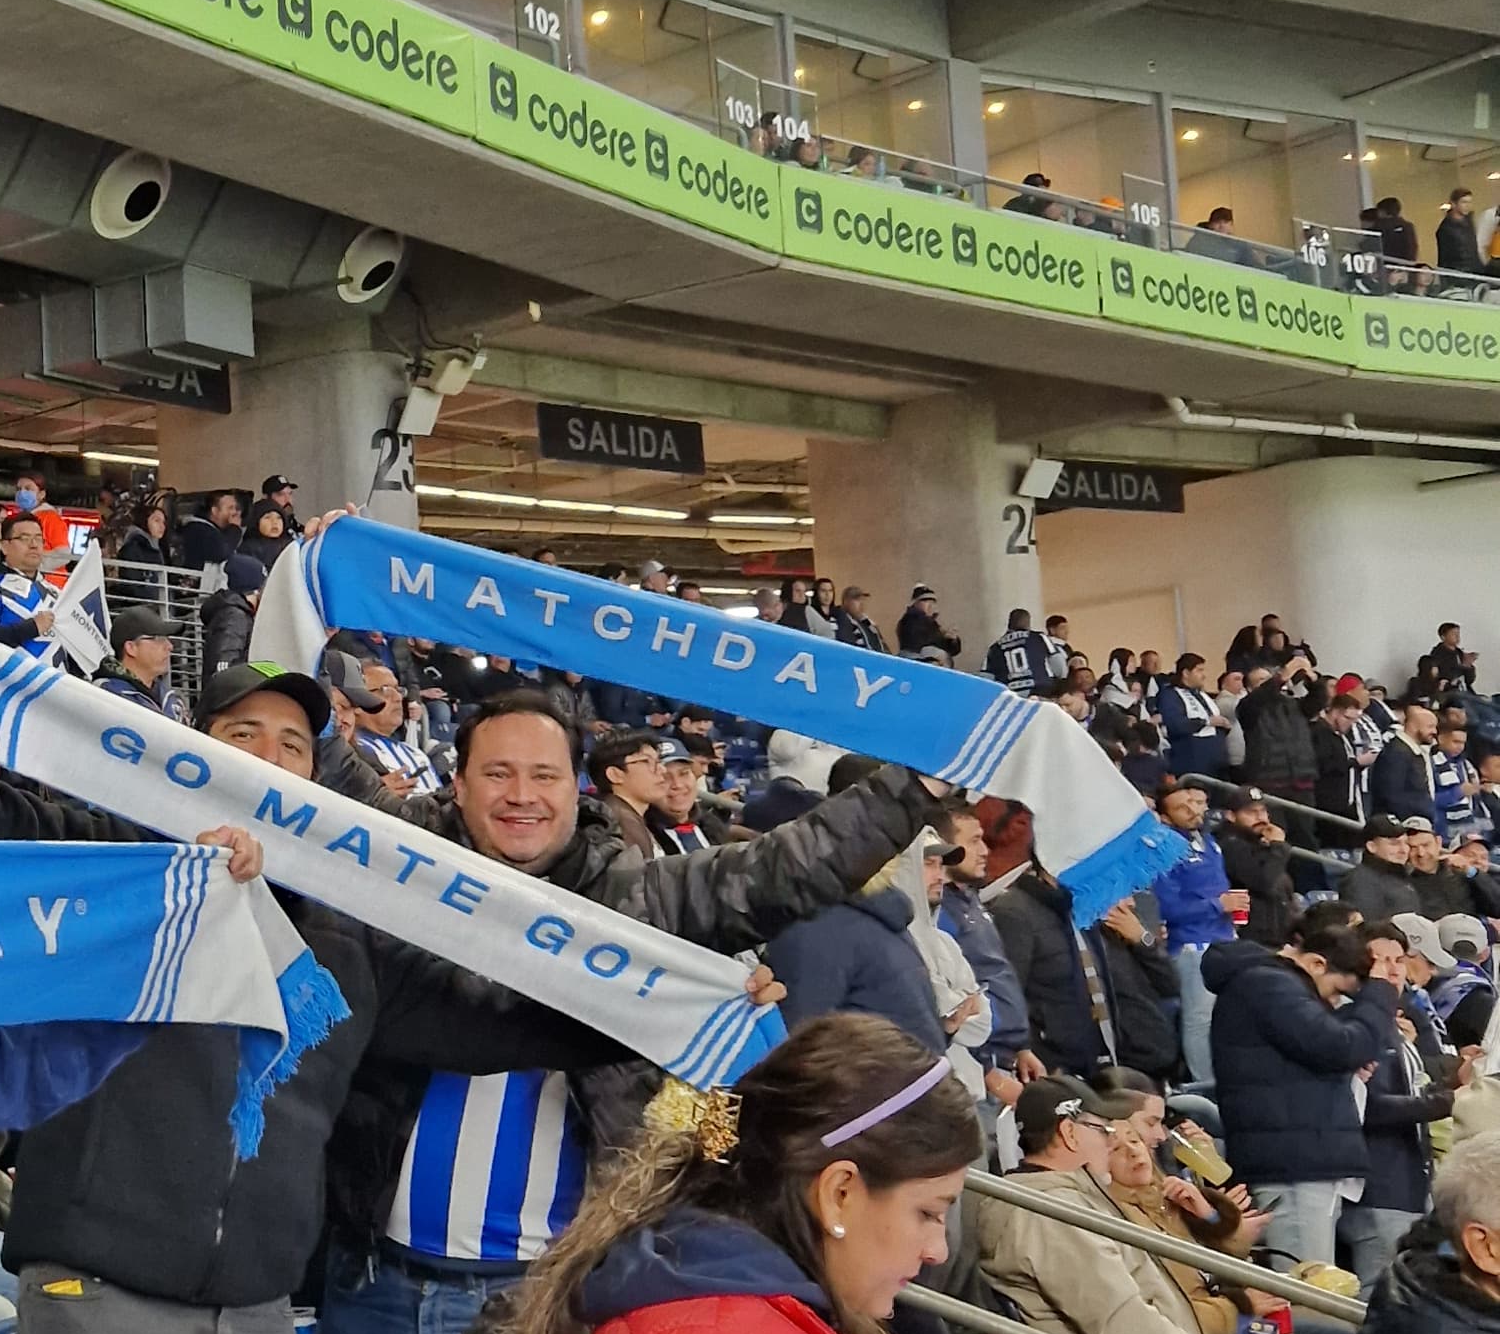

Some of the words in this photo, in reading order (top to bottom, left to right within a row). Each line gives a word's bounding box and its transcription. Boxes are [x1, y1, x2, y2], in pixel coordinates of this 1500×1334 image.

[523, 1, 561, 41] 102
[325, 15, 459, 94] codere
[725, 96, 754, 128] 103
[773, 114, 810, 142] 104
[528, 92, 637, 168] codere
[677, 153, 770, 220] codere
[1130, 202, 1161, 229] 105
[833, 207, 944, 260] codere
[986, 240, 1085, 289] codere
[1301, 243, 1327, 267] 106
[1342, 253, 1376, 274] 107
[1142, 273, 1231, 318] codere
[1265, 298, 1345, 341] codere
[1400, 321, 1499, 360] codere
[567, 417, 680, 462] SALIDA
[1053, 470, 1161, 503] SALIDA
[100, 726, 212, 790] GO
[253, 787, 491, 915] MATE
[525, 914, 669, 998] GO!
